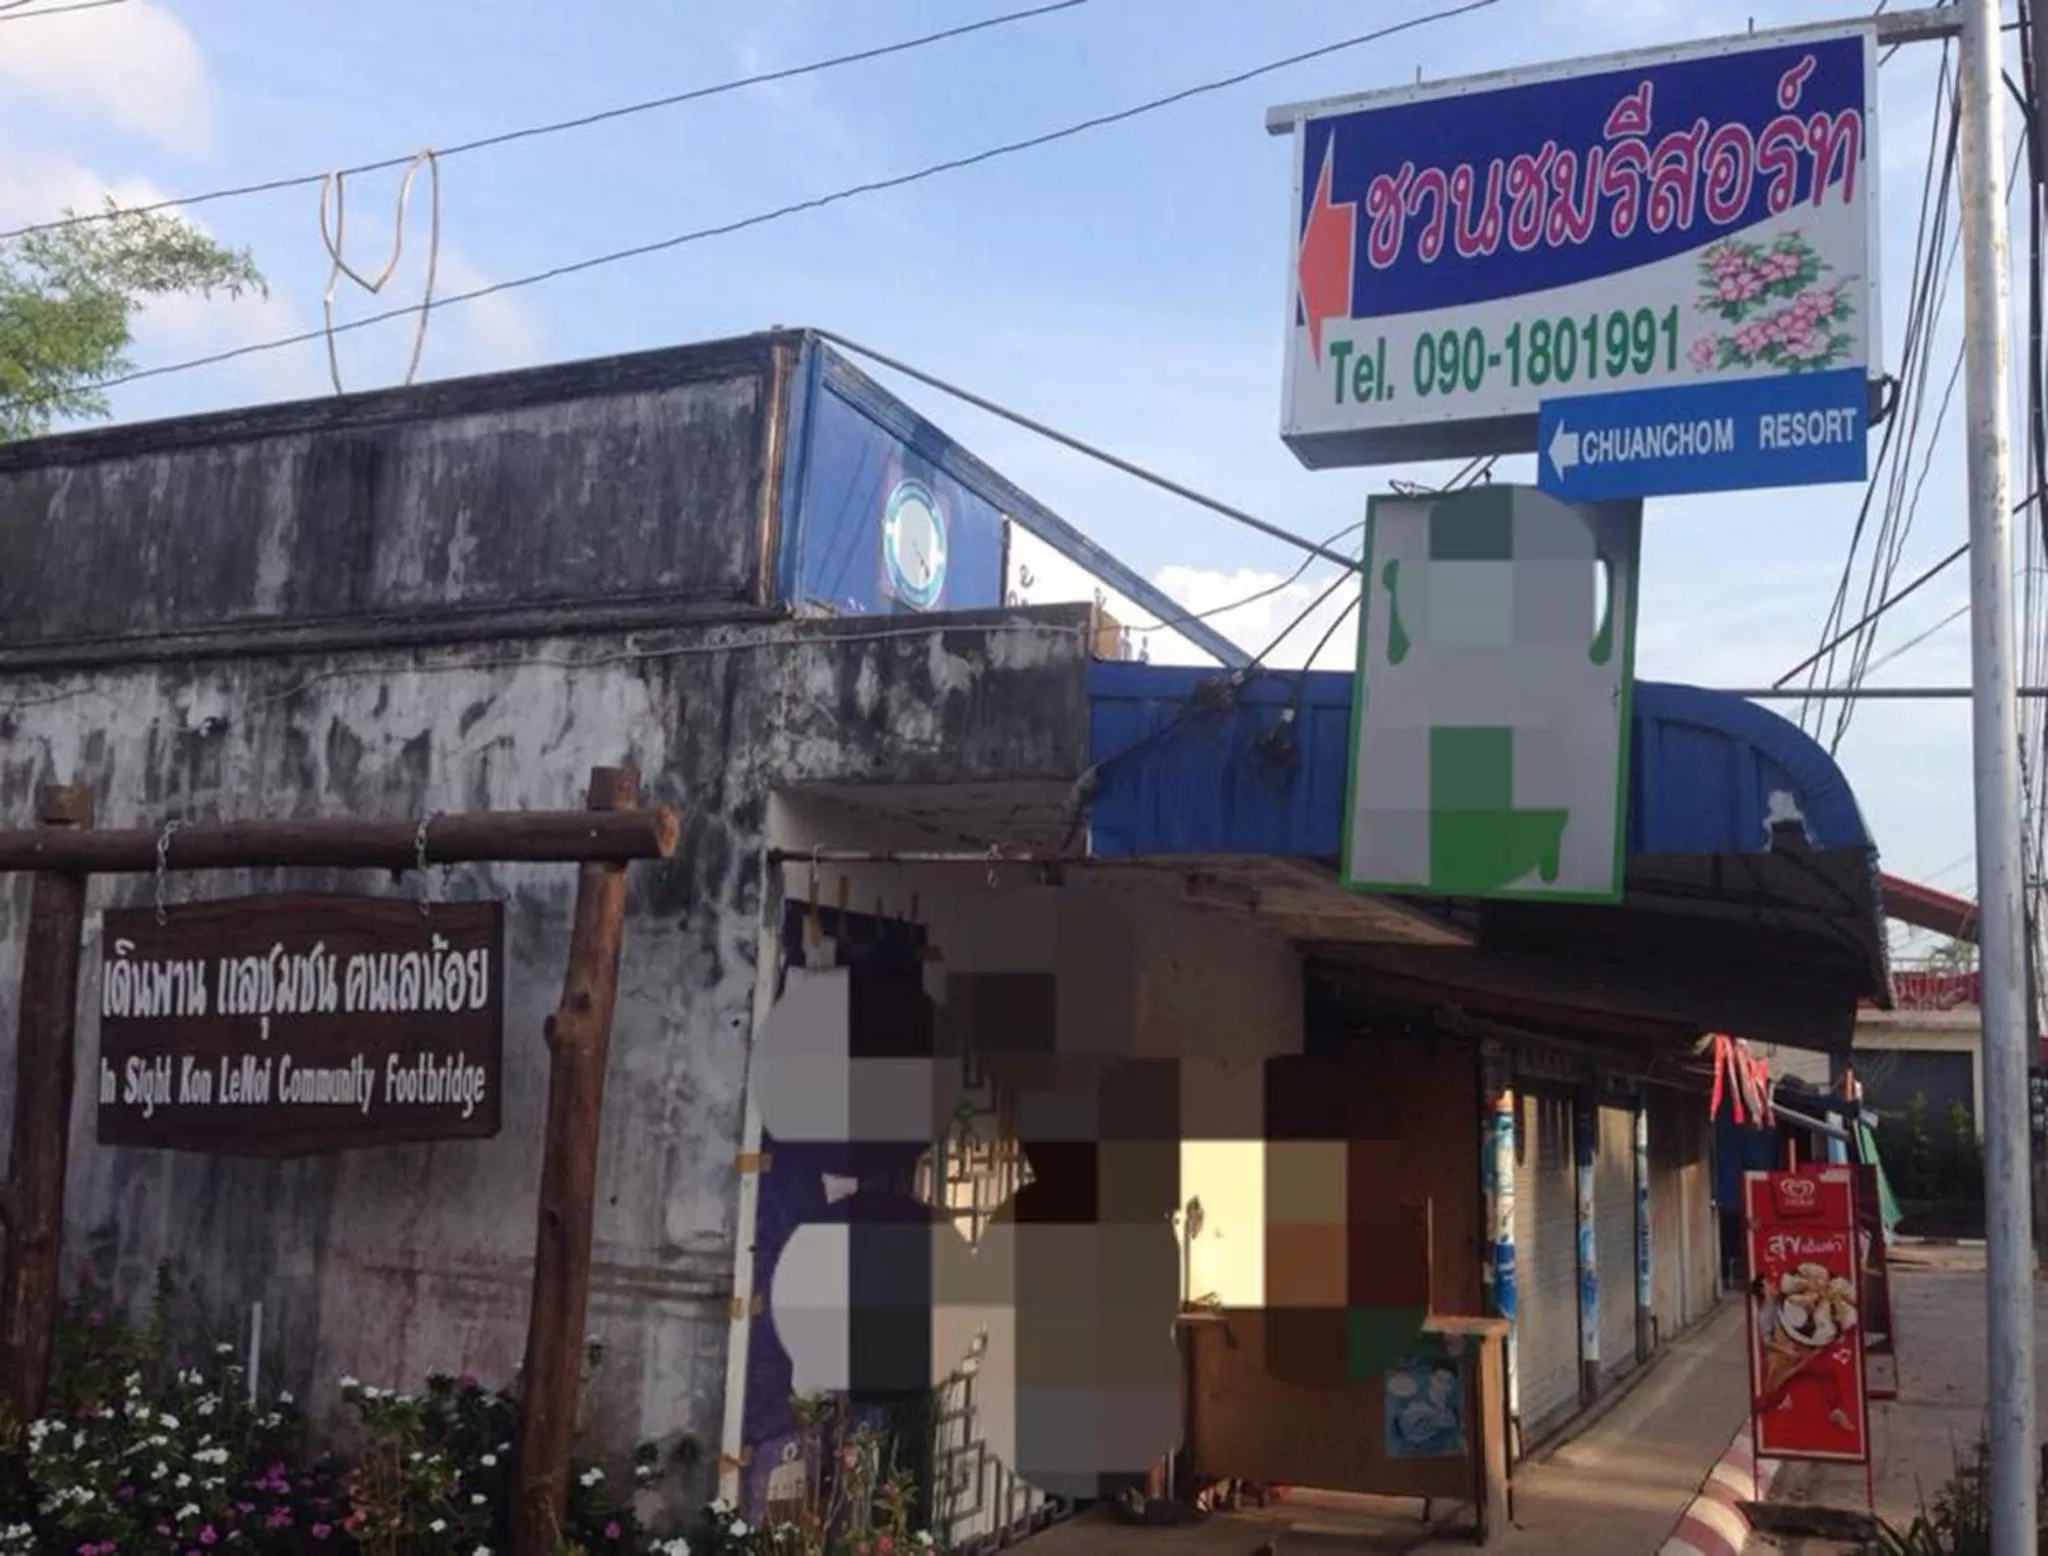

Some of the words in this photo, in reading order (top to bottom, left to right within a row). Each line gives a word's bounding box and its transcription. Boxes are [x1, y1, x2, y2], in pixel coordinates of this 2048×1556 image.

[1367, 55, 1861, 269] ชวนชมรีสอร์ท
[1330, 336, 1395, 404] Tel.
[1414, 304, 1680, 396] 090-1801991
[1581, 417, 1734, 464] CHUANCHOM
[1759, 407, 1857, 449] RESORT
[100, 1057, 116, 1104] In
[124, 1055, 172, 1119] Sight
[179, 1055, 212, 1104] Kon
[278, 1053, 375, 1115] Community
[385, 1051, 486, 1119] Footbridge
